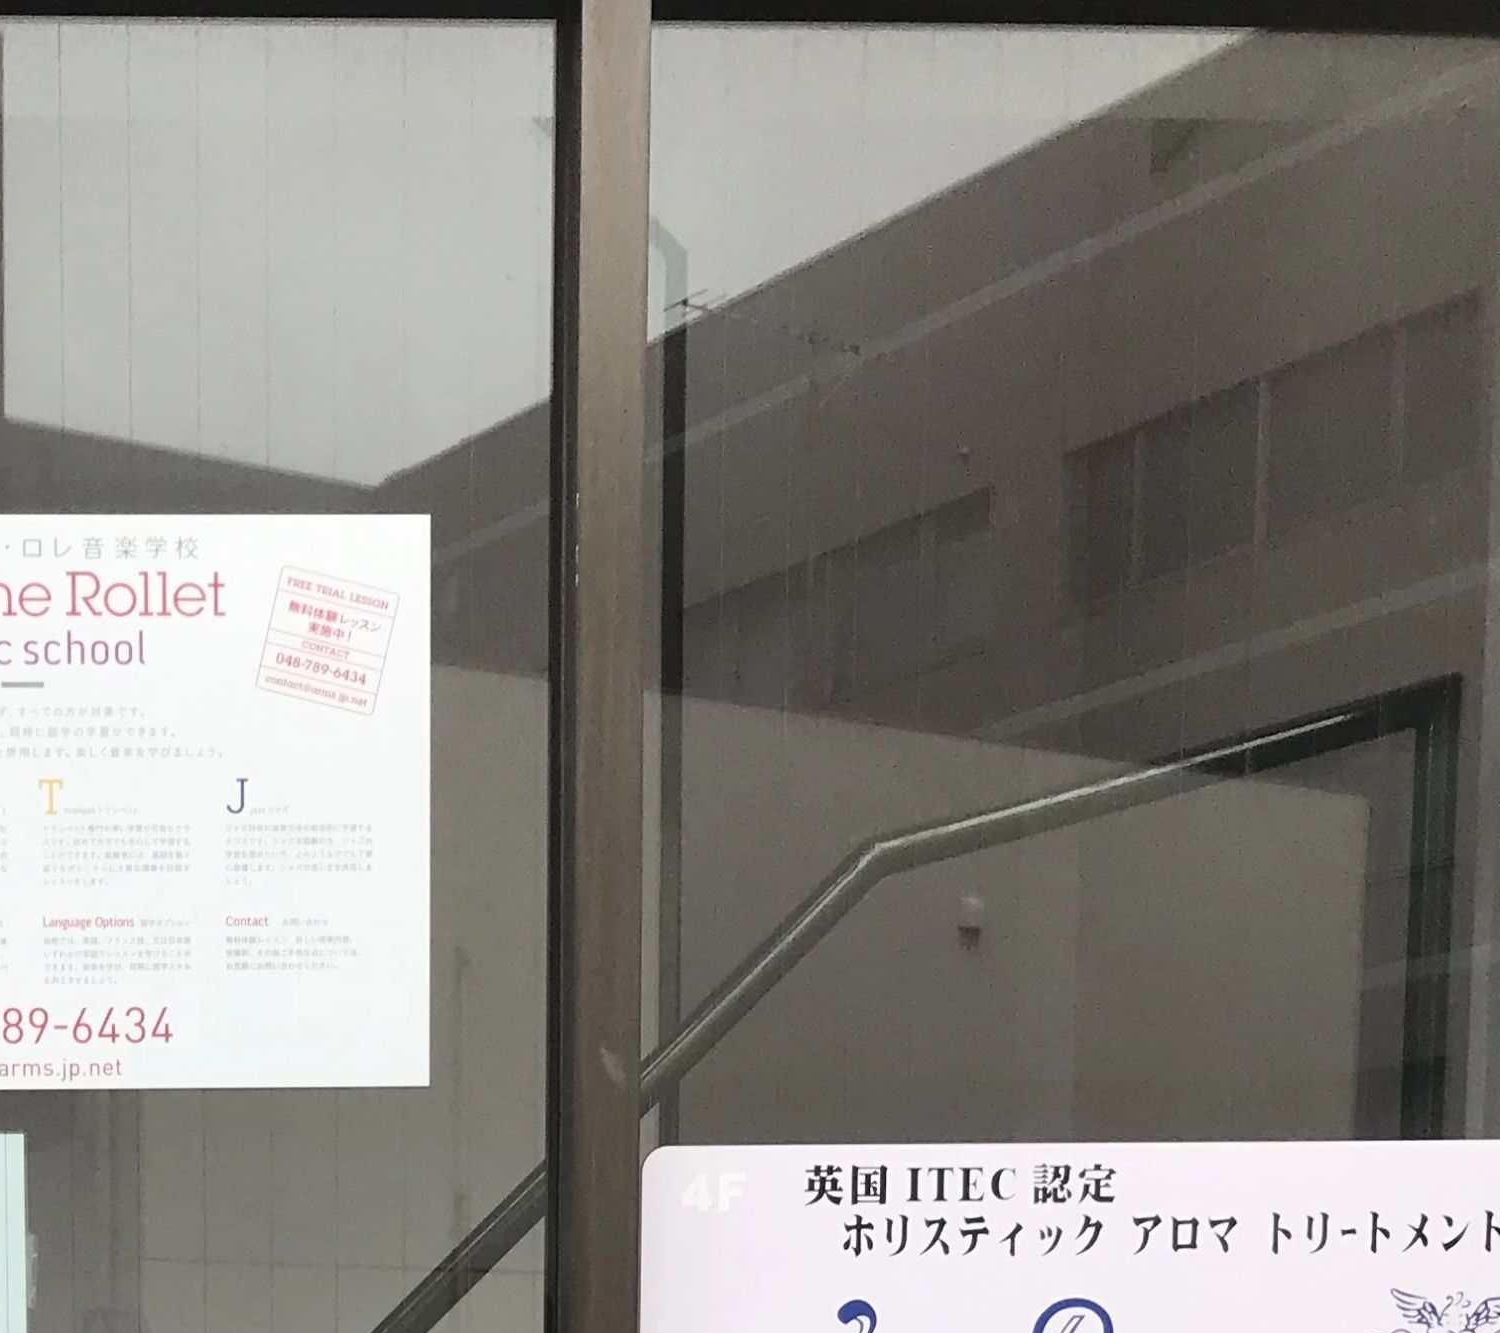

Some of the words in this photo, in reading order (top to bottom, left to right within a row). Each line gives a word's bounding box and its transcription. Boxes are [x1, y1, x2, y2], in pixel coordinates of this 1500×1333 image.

[64, 570, 227, 618] Rollet
[22, 630, 146, 666] school
[301, 640, 350, 660] CONTACT
[276, 652, 367, 686] 048-789-6434
[39, 779, 64, 815] T
[226, 778, 249, 814] J
[42, 916, 92, 930] Language
[94, 916, 135, 930] Options
[225, 915, 270, 928] Contact
[681, 1172, 747, 1213] 4F
[803, 1164, 889, 1206] 英国
[906, 1166, 1017, 1204] ITEC
[1032, 1164, 1118, 1206] 認定
[841, 1212, 1103, 1257] ホリスティック
[1132, 1213, 1239, 1256] アロマ
[1269, 1210, 1500, 1254] トリートメント
